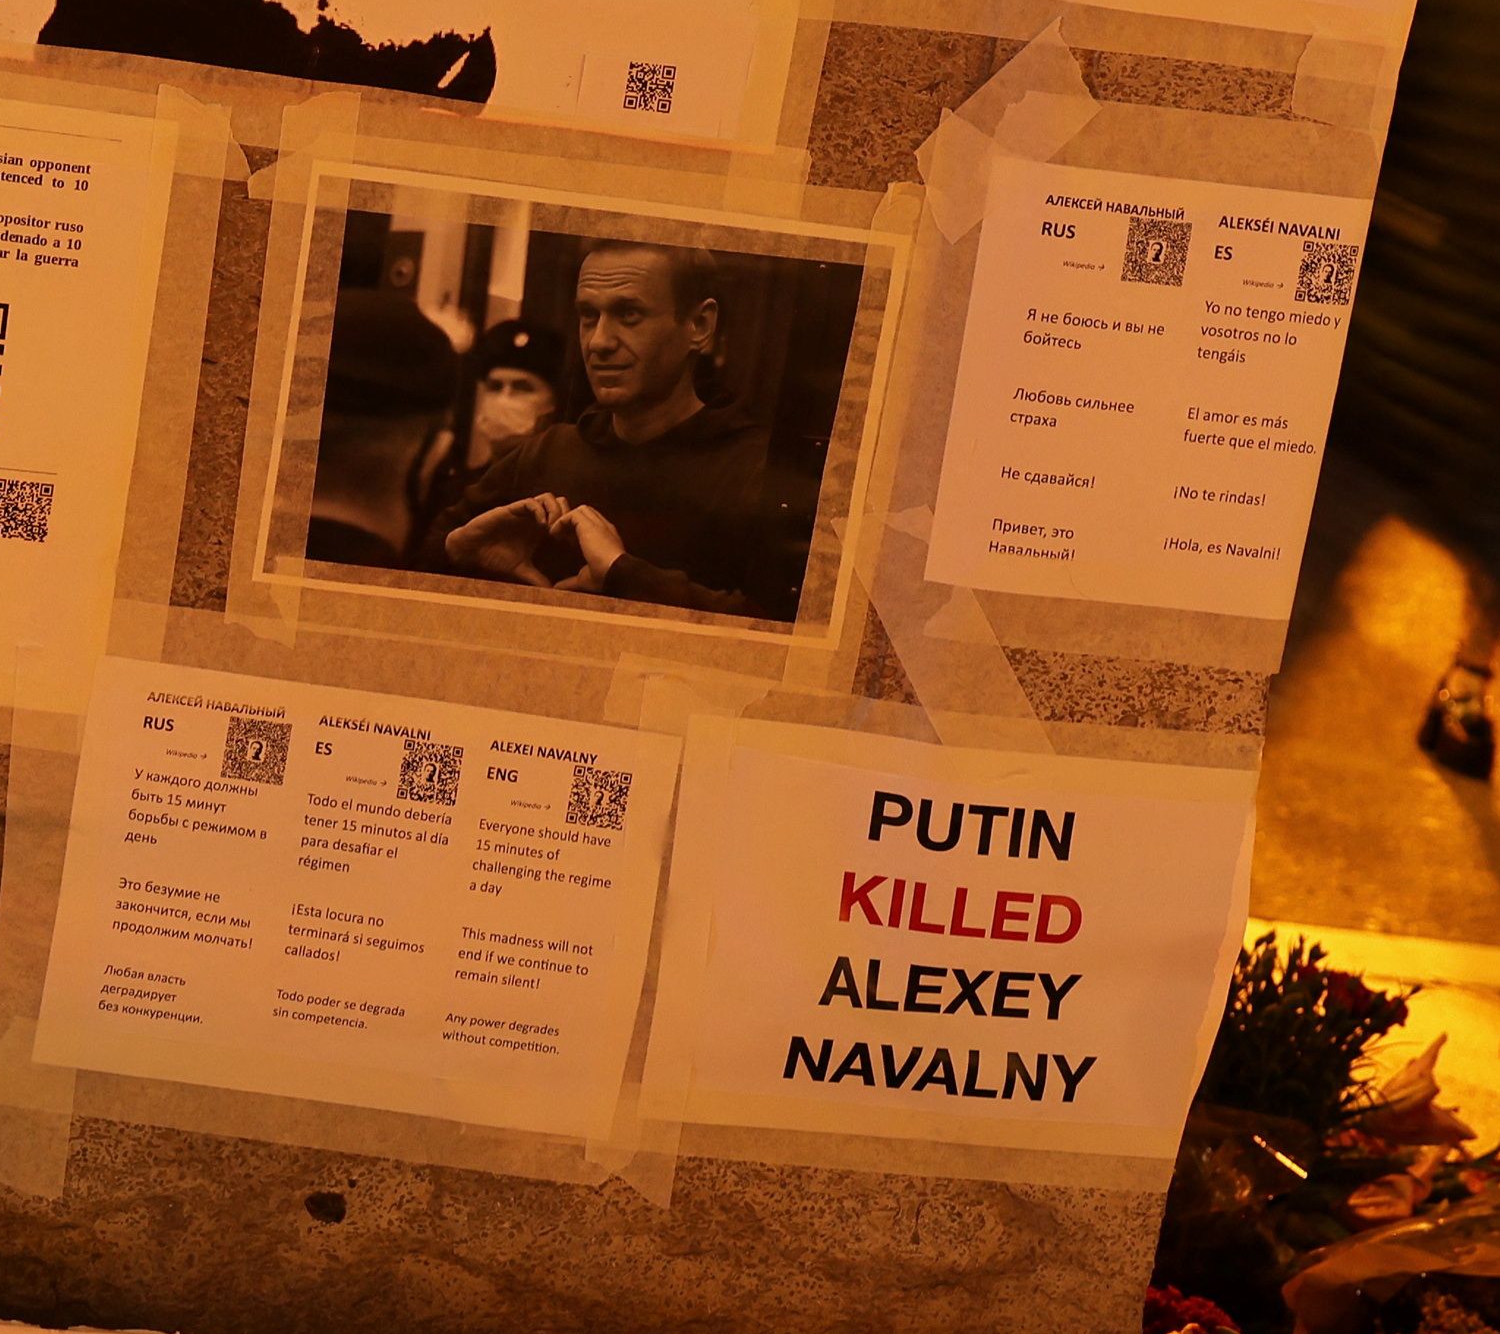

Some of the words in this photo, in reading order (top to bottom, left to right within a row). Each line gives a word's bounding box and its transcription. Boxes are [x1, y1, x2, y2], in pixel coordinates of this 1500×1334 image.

[29, 158, 91, 175] opponent
[51, 176, 65, 189] to
[73, 178, 89, 191] 10
[1044, 193, 1103, 211] АЛЕКСЕЙ
[1105, 200, 1185, 221] НАВАЛЬНЫЙ
[54, 220, 84, 233] ruso
[1040, 220, 1076, 239] RUS
[1277, 221, 1340, 241] NAVALNI
[51, 238, 60, 248] a
[66, 237, 82, 250] 10
[1213, 244, 1233, 261] ES
[14, 247, 28, 261] la
[33, 253, 79, 268] guerra
[1025, 307, 1037, 321] Я
[1040, 311, 1059, 324] не
[1062, 311, 1108, 330] боюсь
[1111, 320, 1121, 331] и
[1124, 321, 1144, 333] вы
[1146, 324, 1165, 336] не
[1204, 299, 1220, 314] Yo
[1223, 305, 1242, 317] no
[1245, 305, 1285, 324] tengo
[1288, 310, 1331, 326] miedo
[1333, 316, 1341, 330] y
[1022, 329, 1082, 350] бойтесь
[1200, 325, 1259, 342] vosotros
[1262, 332, 1281, 344] no
[1283, 331, 1297, 346] lo
[1196, 346, 1246, 364] tengáis
[1012, 387, 1072, 406] Любовь
[1074, 397, 1134, 413] сильнее
[1009, 411, 1057, 427] страха
[1186, 406, 1200, 420] El
[1202, 410, 1240, 424] amor
[1241, 415, 1257, 426] es
[1260, 415, 1288, 429] más
[1183, 428, 1225, 446] fuerte
[1228, 436, 1254, 450] que
[1257, 436, 1271, 450] el
[1000, 465, 1020, 480] Не
[1023, 470, 1095, 489] сдавайся!
[1201, 488, 1216, 502] te
[1218, 489, 1266, 506] rindas!
[991, 517, 1047, 538] Привет,
[1050, 527, 1074, 539] это
[988, 539, 1075, 560] Навальный!
[1206, 543, 1222, 554] es
[1225, 542, 1281, 560] Navalni!
[489, 739, 534, 756] ALEXEI
[536, 745, 598, 765] NAVALNY
[486, 765, 518, 783] ENG
[478, 817, 535, 837] Everyone
[537, 825, 579, 843] should
[581, 831, 611, 847] have
[867, 790, 1076, 862] PUTIN
[475, 838, 491, 851] 15
[493, 841, 543, 859] minutes
[545, 847, 561, 861] of
[471, 858, 542, 882] challenging
[544, 868, 565, 882] the
[567, 873, 612, 889] regime
[468, 881, 476, 891] a
[479, 880, 502, 897] day
[837, 870, 1083, 945] KILLED
[461, 925, 486, 941] This
[488, 932, 544, 949] madness
[546, 938, 569, 952] will
[571, 944, 593, 956] not
[457, 948, 482, 961] end
[484, 949, 495, 963] if
[496, 954, 515, 966] we
[517, 957, 573, 974] continue
[575, 963, 589, 976] to
[454, 969, 498, 984] remain
[500, 973, 540, 989] silent!
[818, 955, 1083, 1021] ALEXEY
[781, 1035, 1098, 1104] NAVALNY
